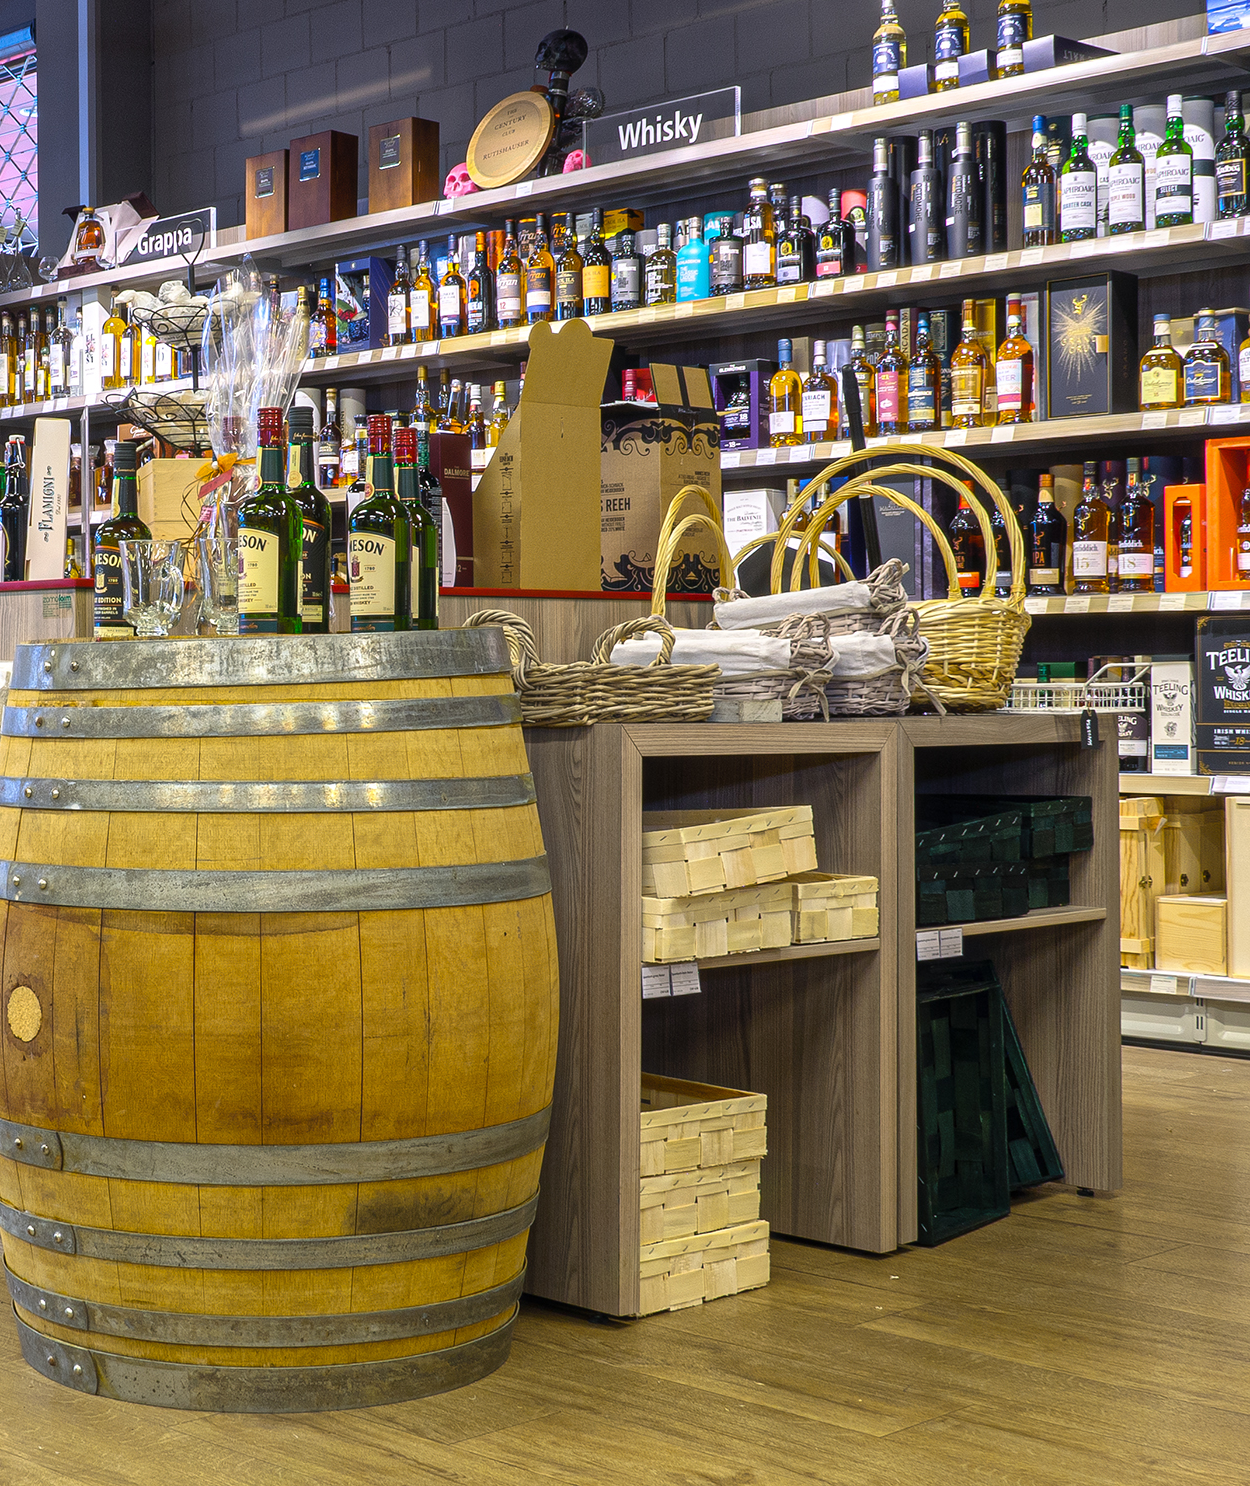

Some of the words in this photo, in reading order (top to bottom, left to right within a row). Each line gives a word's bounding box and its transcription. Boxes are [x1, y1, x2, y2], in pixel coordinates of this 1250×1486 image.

[494, 114, 527, 130] CENTURY
[502, 129, 515, 137] CLUB
[617, 110, 703, 151] Whisky
[483, 139, 529, 160] RUTISHAUSER
[1159, 184, 1178, 193] SELECT
[137, 227, 192, 256] Grappa
[1069, 345, 1089, 354] CRU
[739, 413, 748, 421] 18
[443, 468, 470, 477] DALMORE
[37, 476, 56, 532] FLAMIGNI
[605, 497, 631, 512] REEH
[1032, 551, 1045, 564] IPA
[1076, 557, 1090, 570] 15
[1122, 556, 1136, 570] 18
[1152, 682, 1188, 695] TEELING
[1156, 704, 1184, 713] WHISKEY
[1235, 736, 1246, 746] 18
